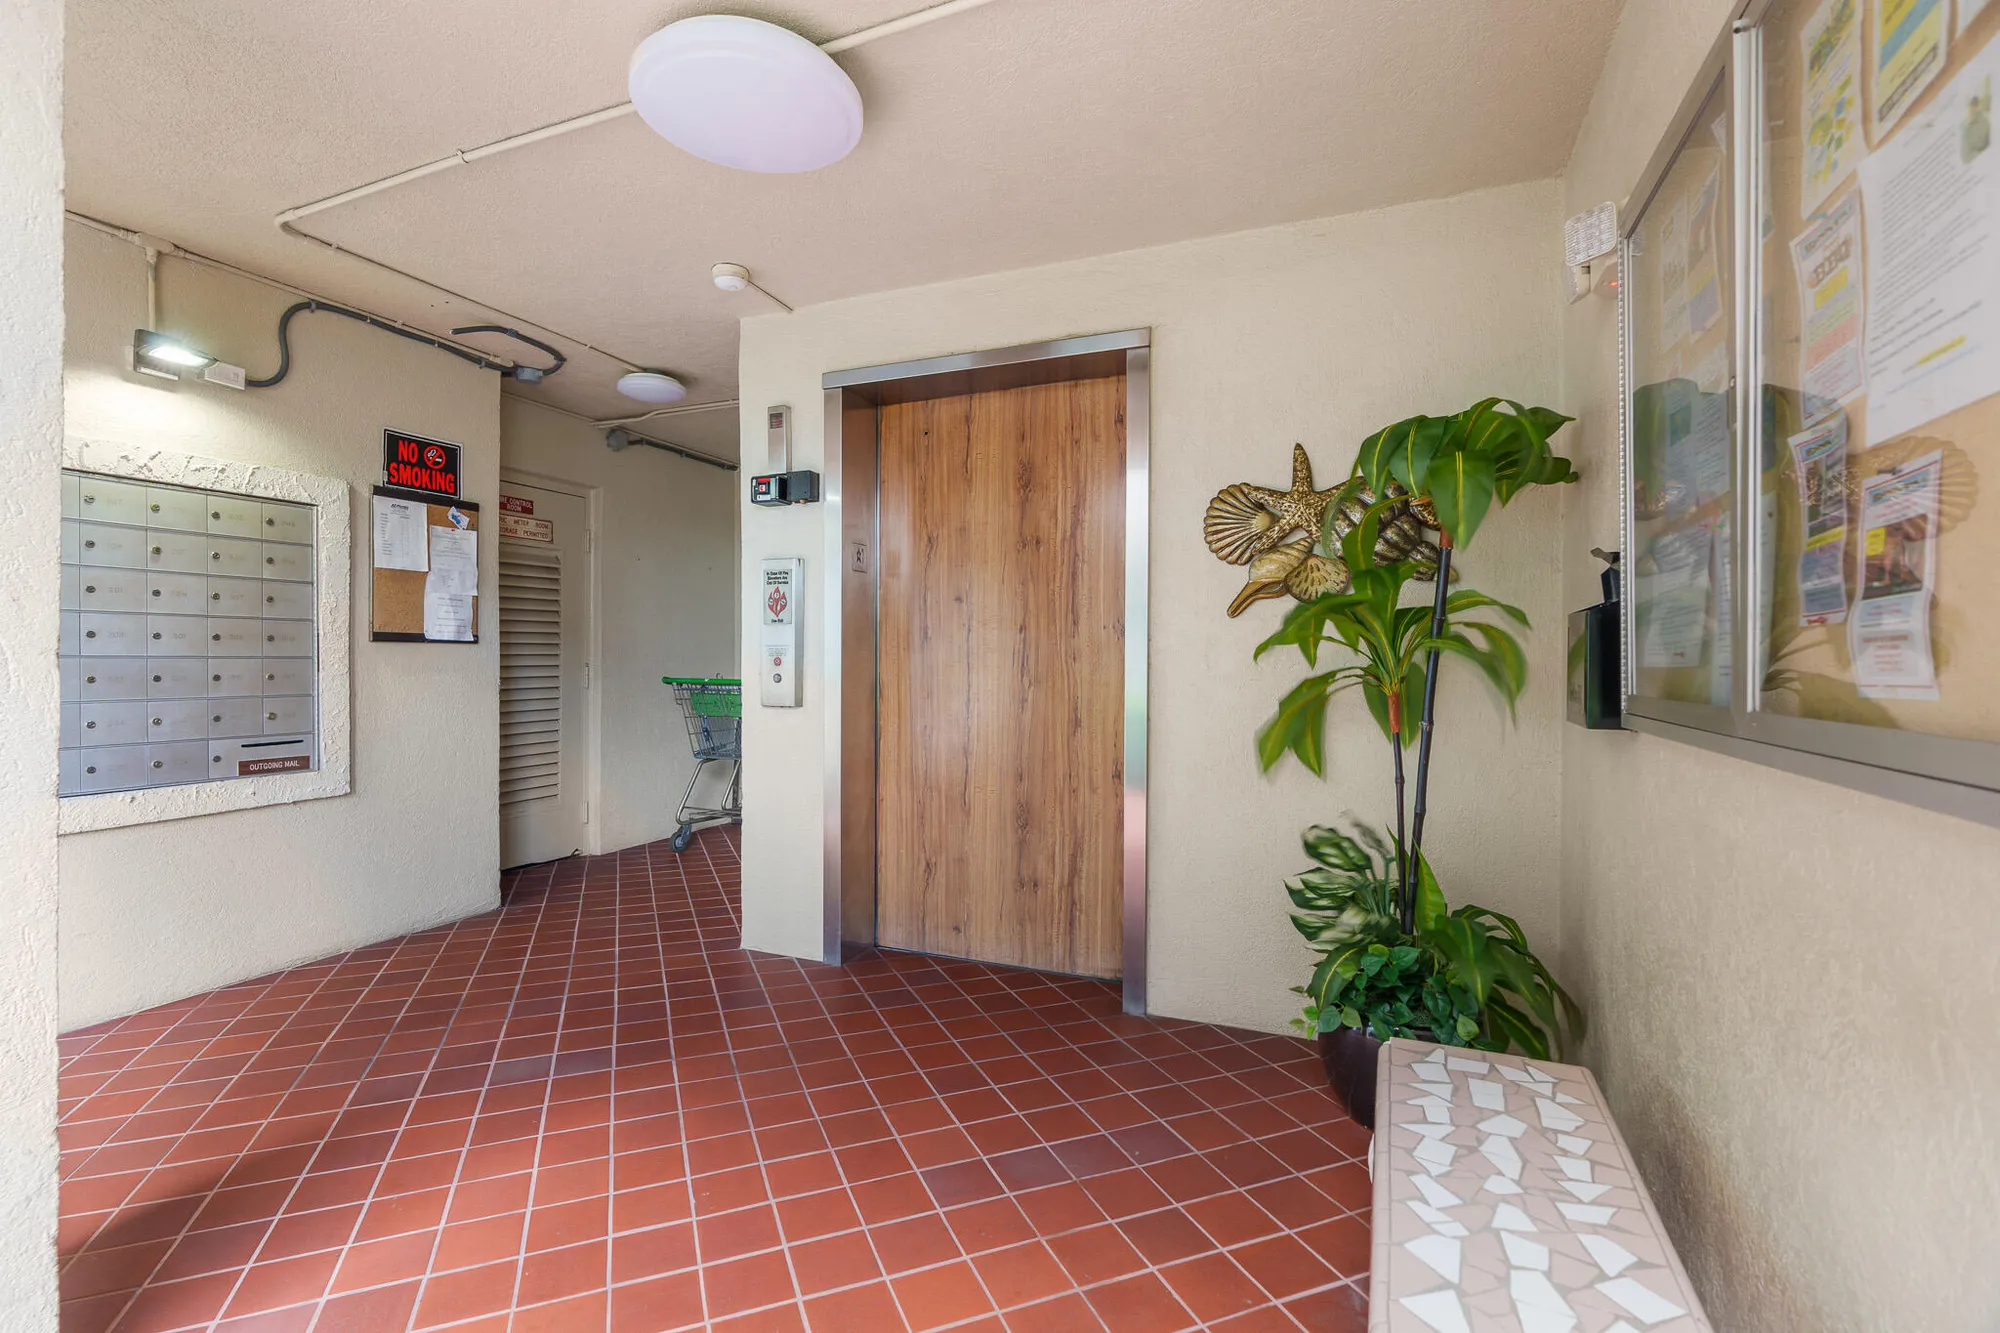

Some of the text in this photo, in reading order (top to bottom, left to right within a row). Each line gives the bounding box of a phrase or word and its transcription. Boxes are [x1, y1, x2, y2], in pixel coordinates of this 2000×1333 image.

[398, 440, 419, 464] NO
[389, 462, 456, 494] SMOKING
[510, 498, 533, 509] CONTROL
[249, 760, 301, 771] OUTGOING MAIL
